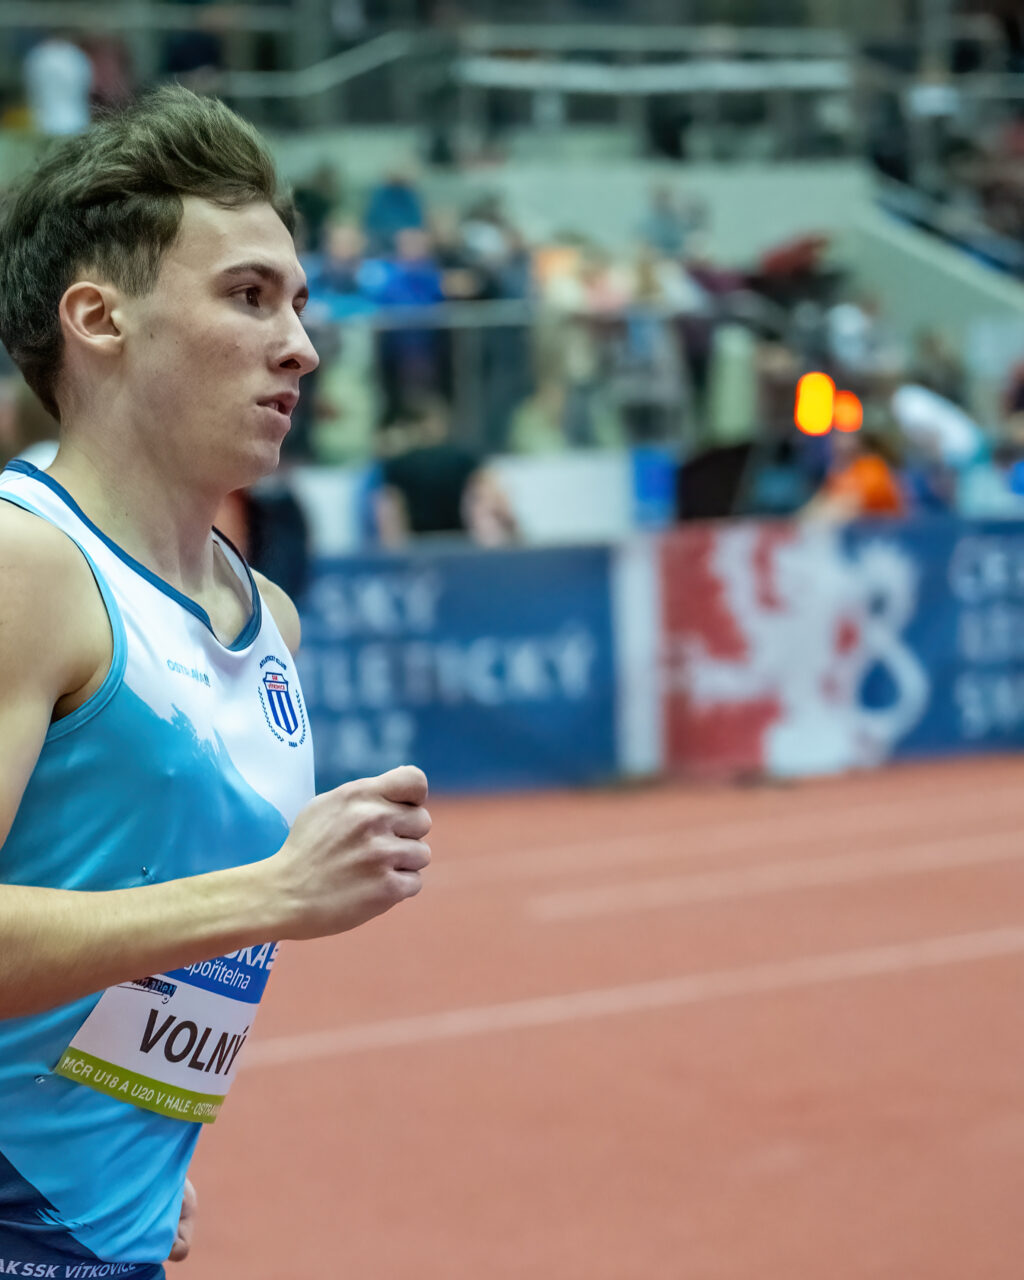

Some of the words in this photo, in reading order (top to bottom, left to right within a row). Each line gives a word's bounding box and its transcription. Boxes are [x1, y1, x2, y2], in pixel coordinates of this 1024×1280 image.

[140, 1008, 249, 1075] VOLNÝ
[61, 1057, 93, 1078] MČR
[94, 1069, 119, 1088] U18
[118, 1080, 129, 1093] A
[130, 1084, 155, 1102] U20
[156, 1091, 166, 1105] V
[164, 1095, 192, 1113] HALE
